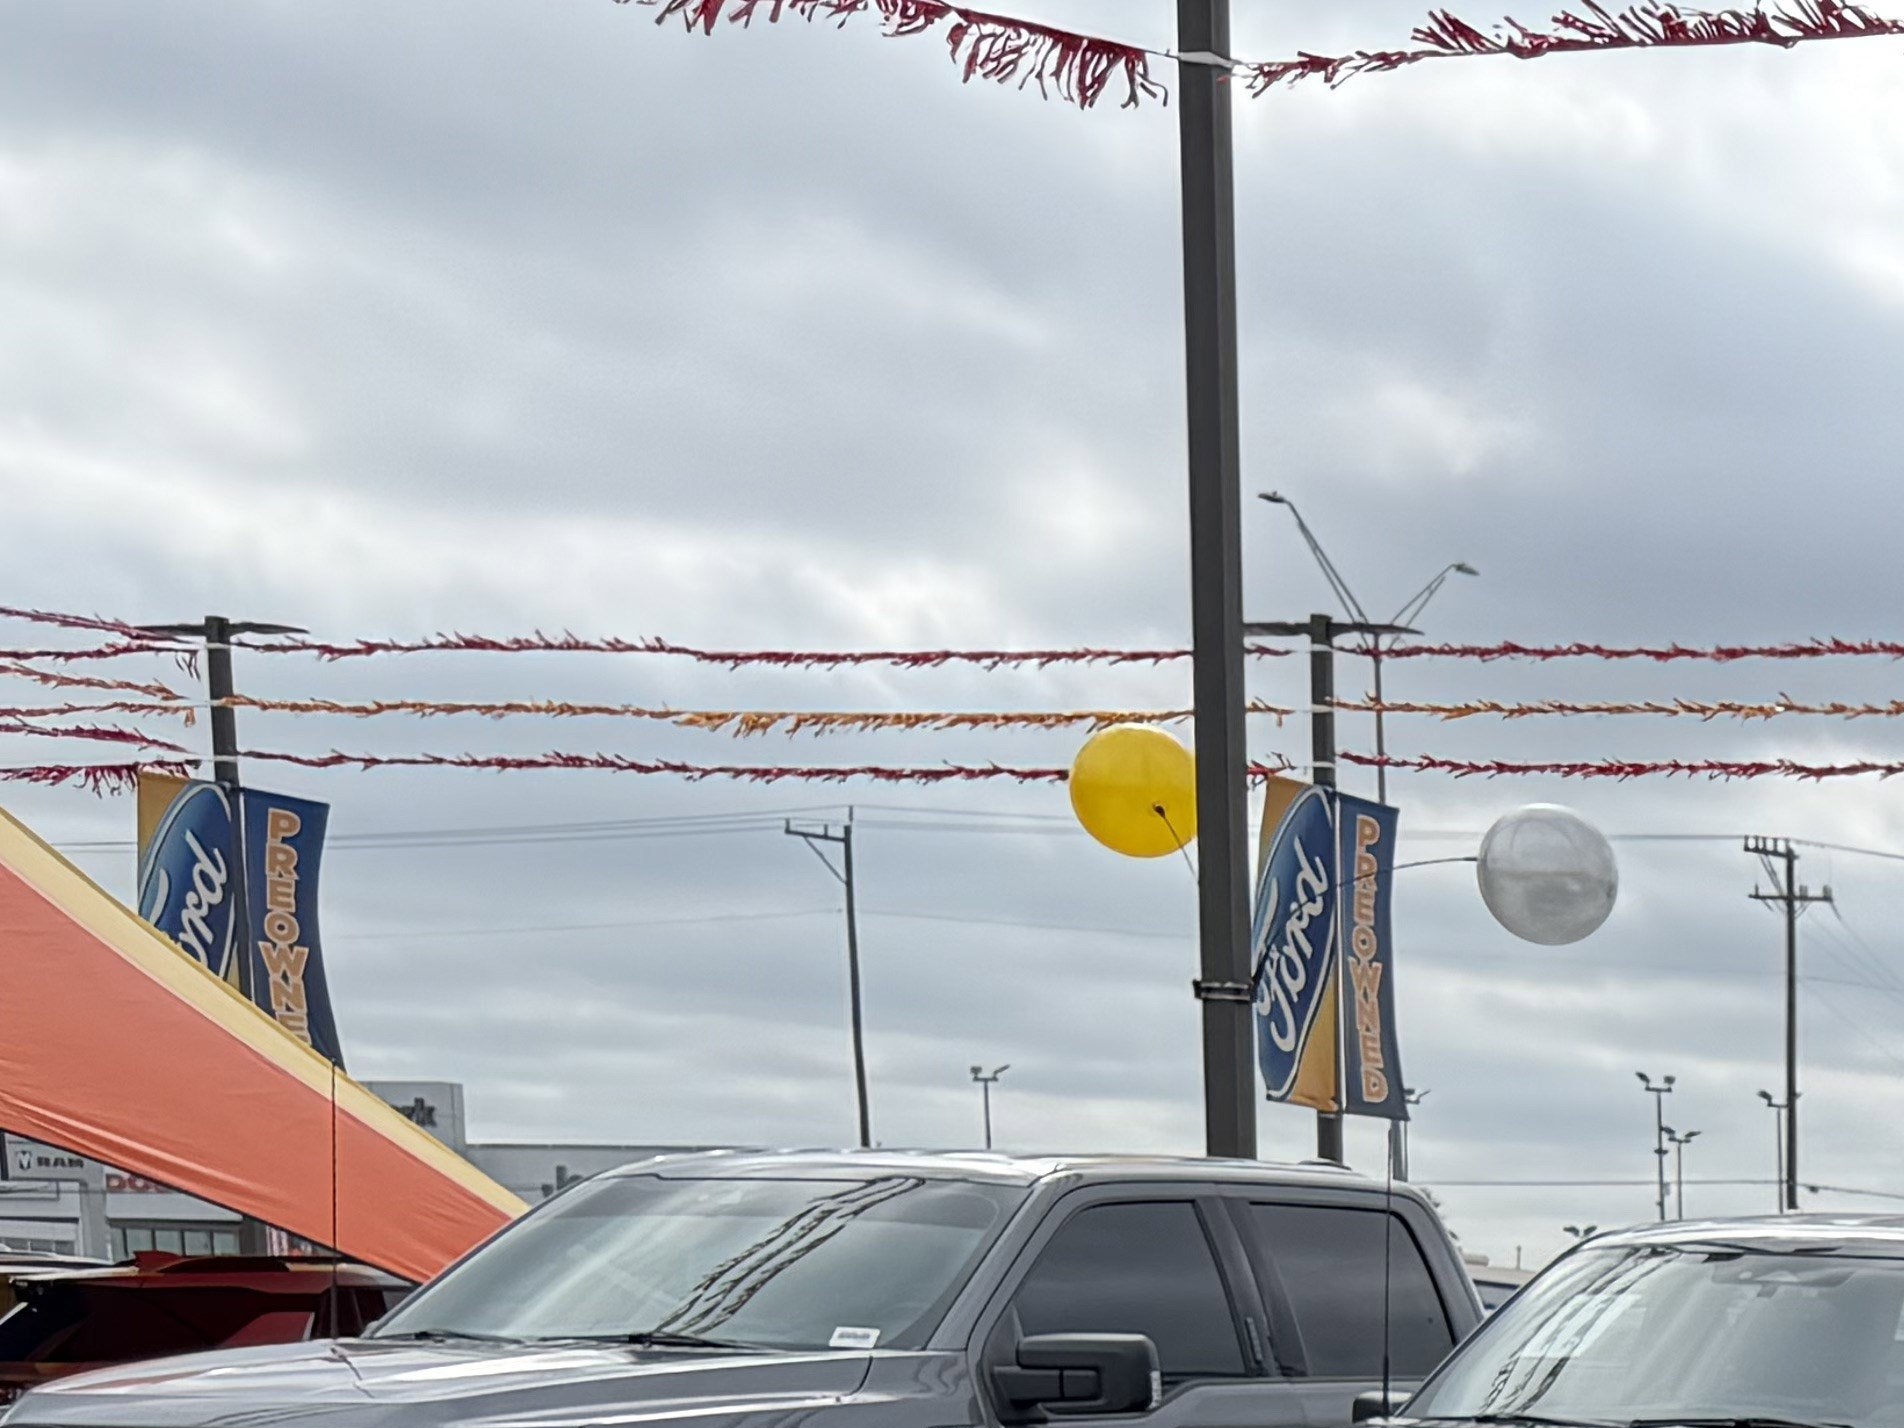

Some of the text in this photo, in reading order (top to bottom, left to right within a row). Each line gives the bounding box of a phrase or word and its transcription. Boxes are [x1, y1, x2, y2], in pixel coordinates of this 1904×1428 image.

[1252, 834, 1329, 1053] Ford
[1348, 813, 1389, 1103] PREOWNED
[37, 1156, 85, 1168] RAM
